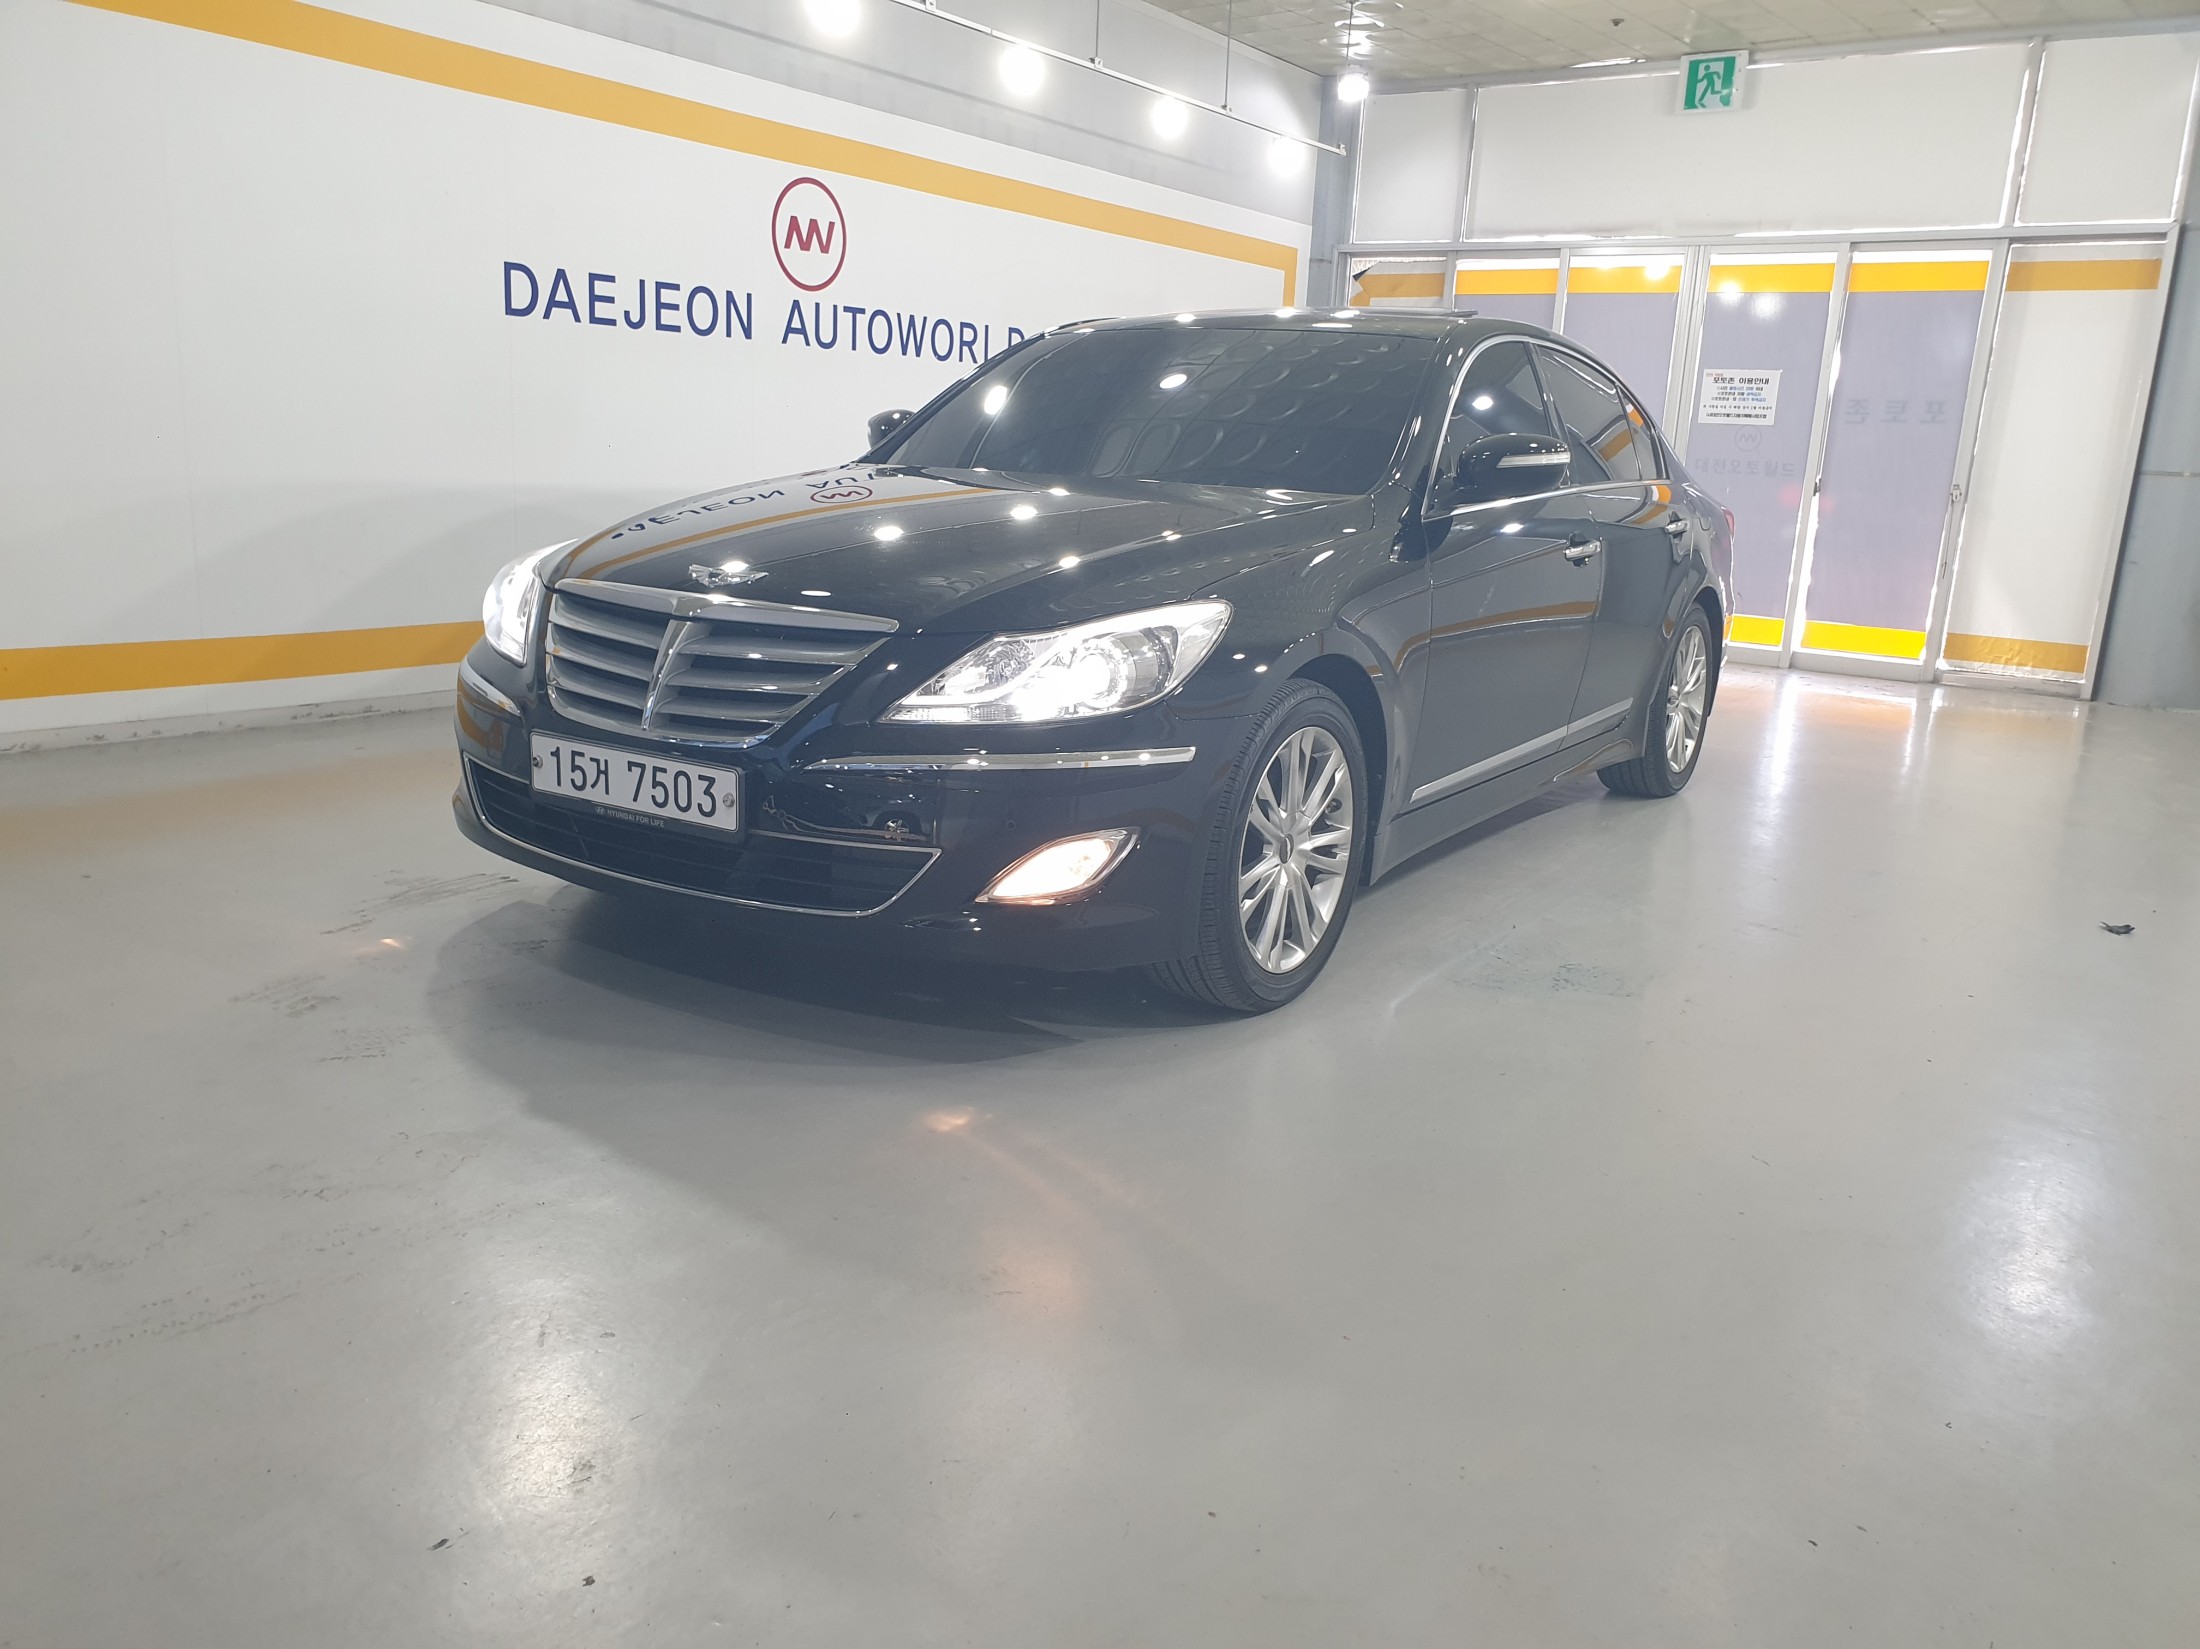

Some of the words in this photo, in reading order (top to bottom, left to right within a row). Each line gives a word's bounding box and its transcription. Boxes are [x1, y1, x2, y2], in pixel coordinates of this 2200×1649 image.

[504, 261, 752, 340] DAEJEON
[1712, 377, 1735, 385] 포토존
[550, 746, 610, 796] 15거
[627, 760, 717, 818] 7503
[607, 809, 635, 821] HYUNDAI
[636, 815, 649, 824] FOR
[650, 819, 665, 828] LIFE
